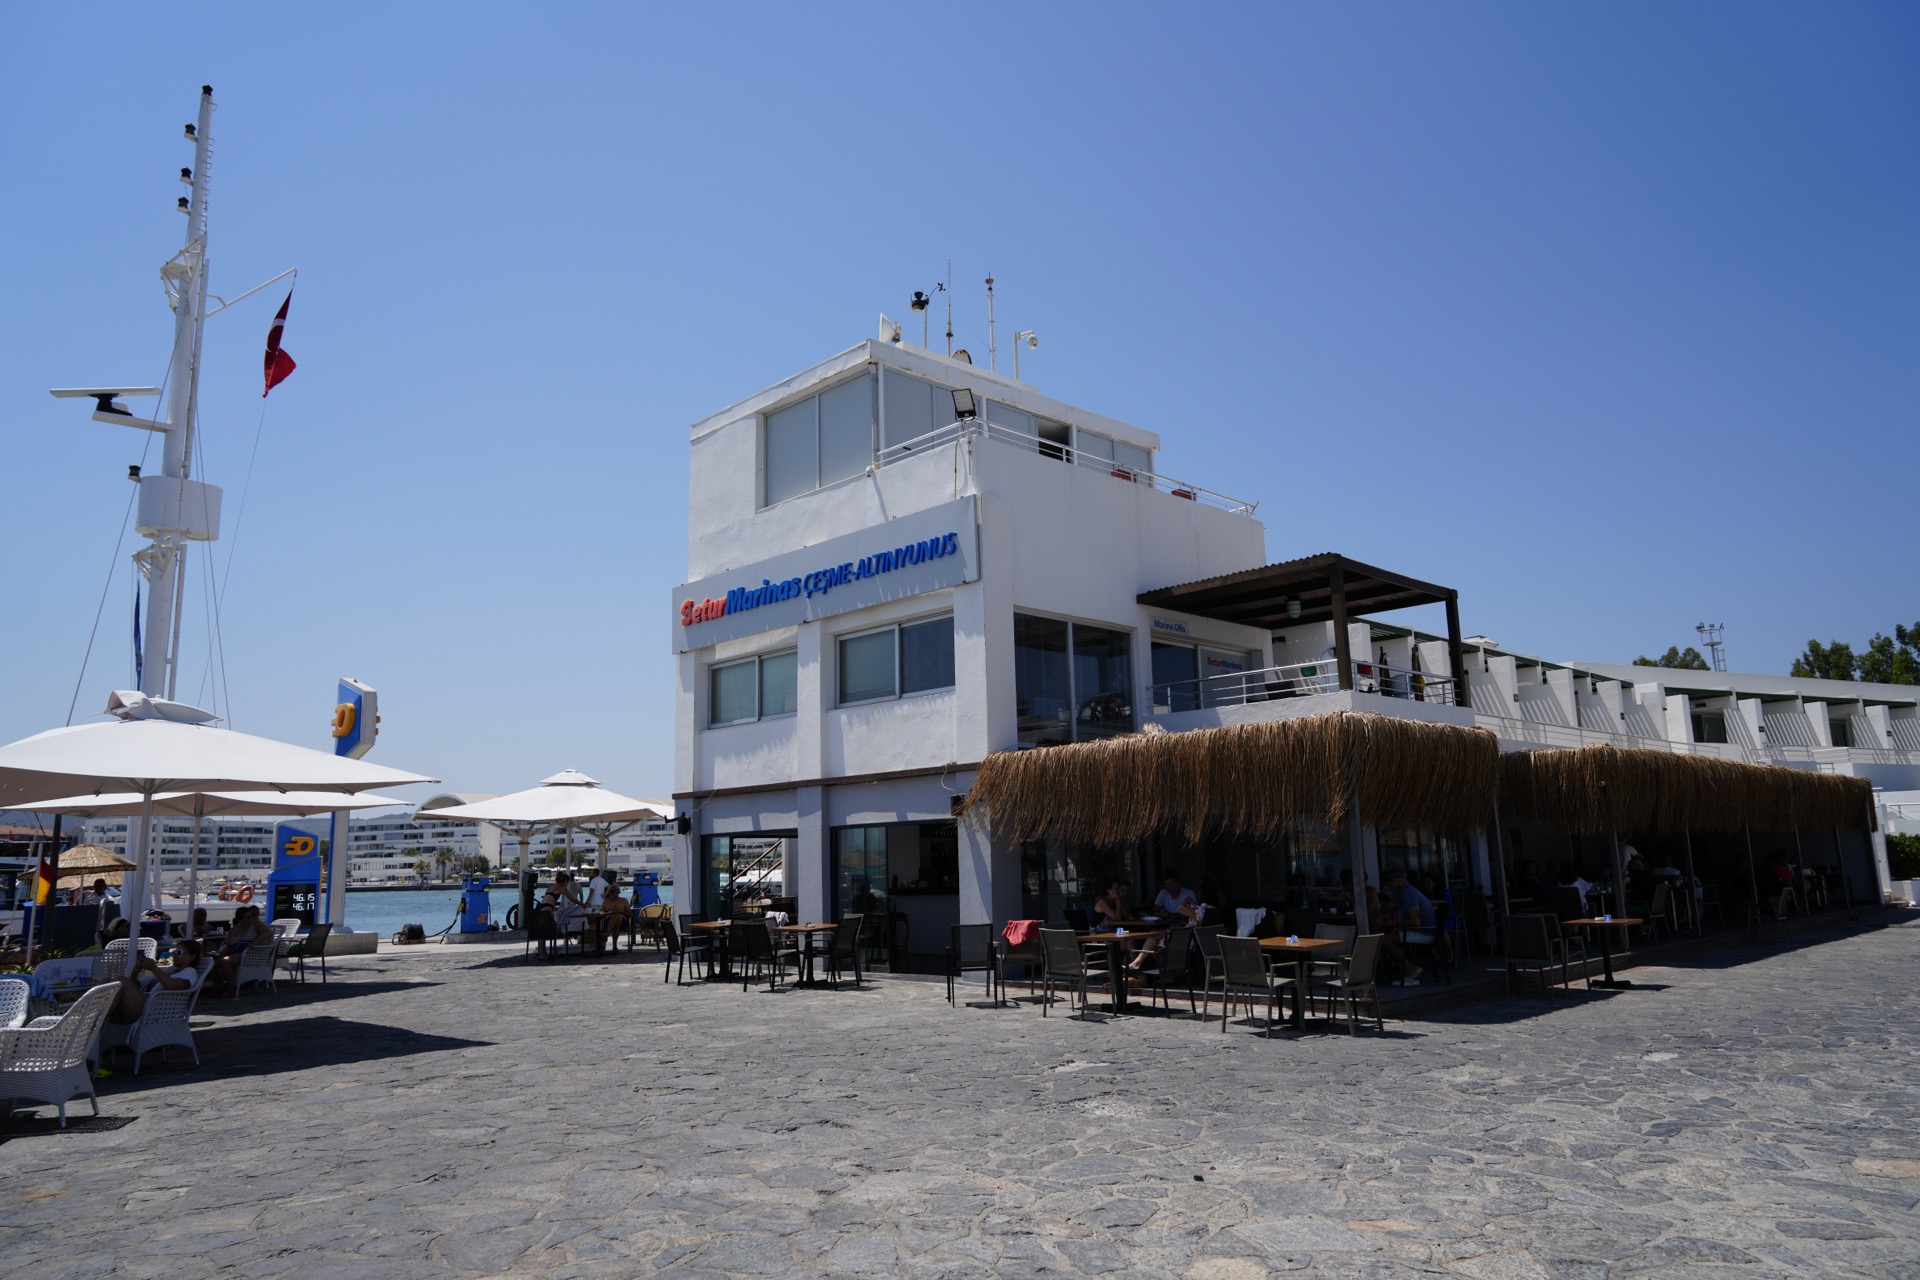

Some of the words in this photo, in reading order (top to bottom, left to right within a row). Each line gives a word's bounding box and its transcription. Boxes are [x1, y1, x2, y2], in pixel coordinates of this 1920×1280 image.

[803, 532, 957, 598] ÇEŞME-ALTINYUNUS
[1154, 620, 1174, 631] Marina
[1174, 622, 1185, 633] Ofis
